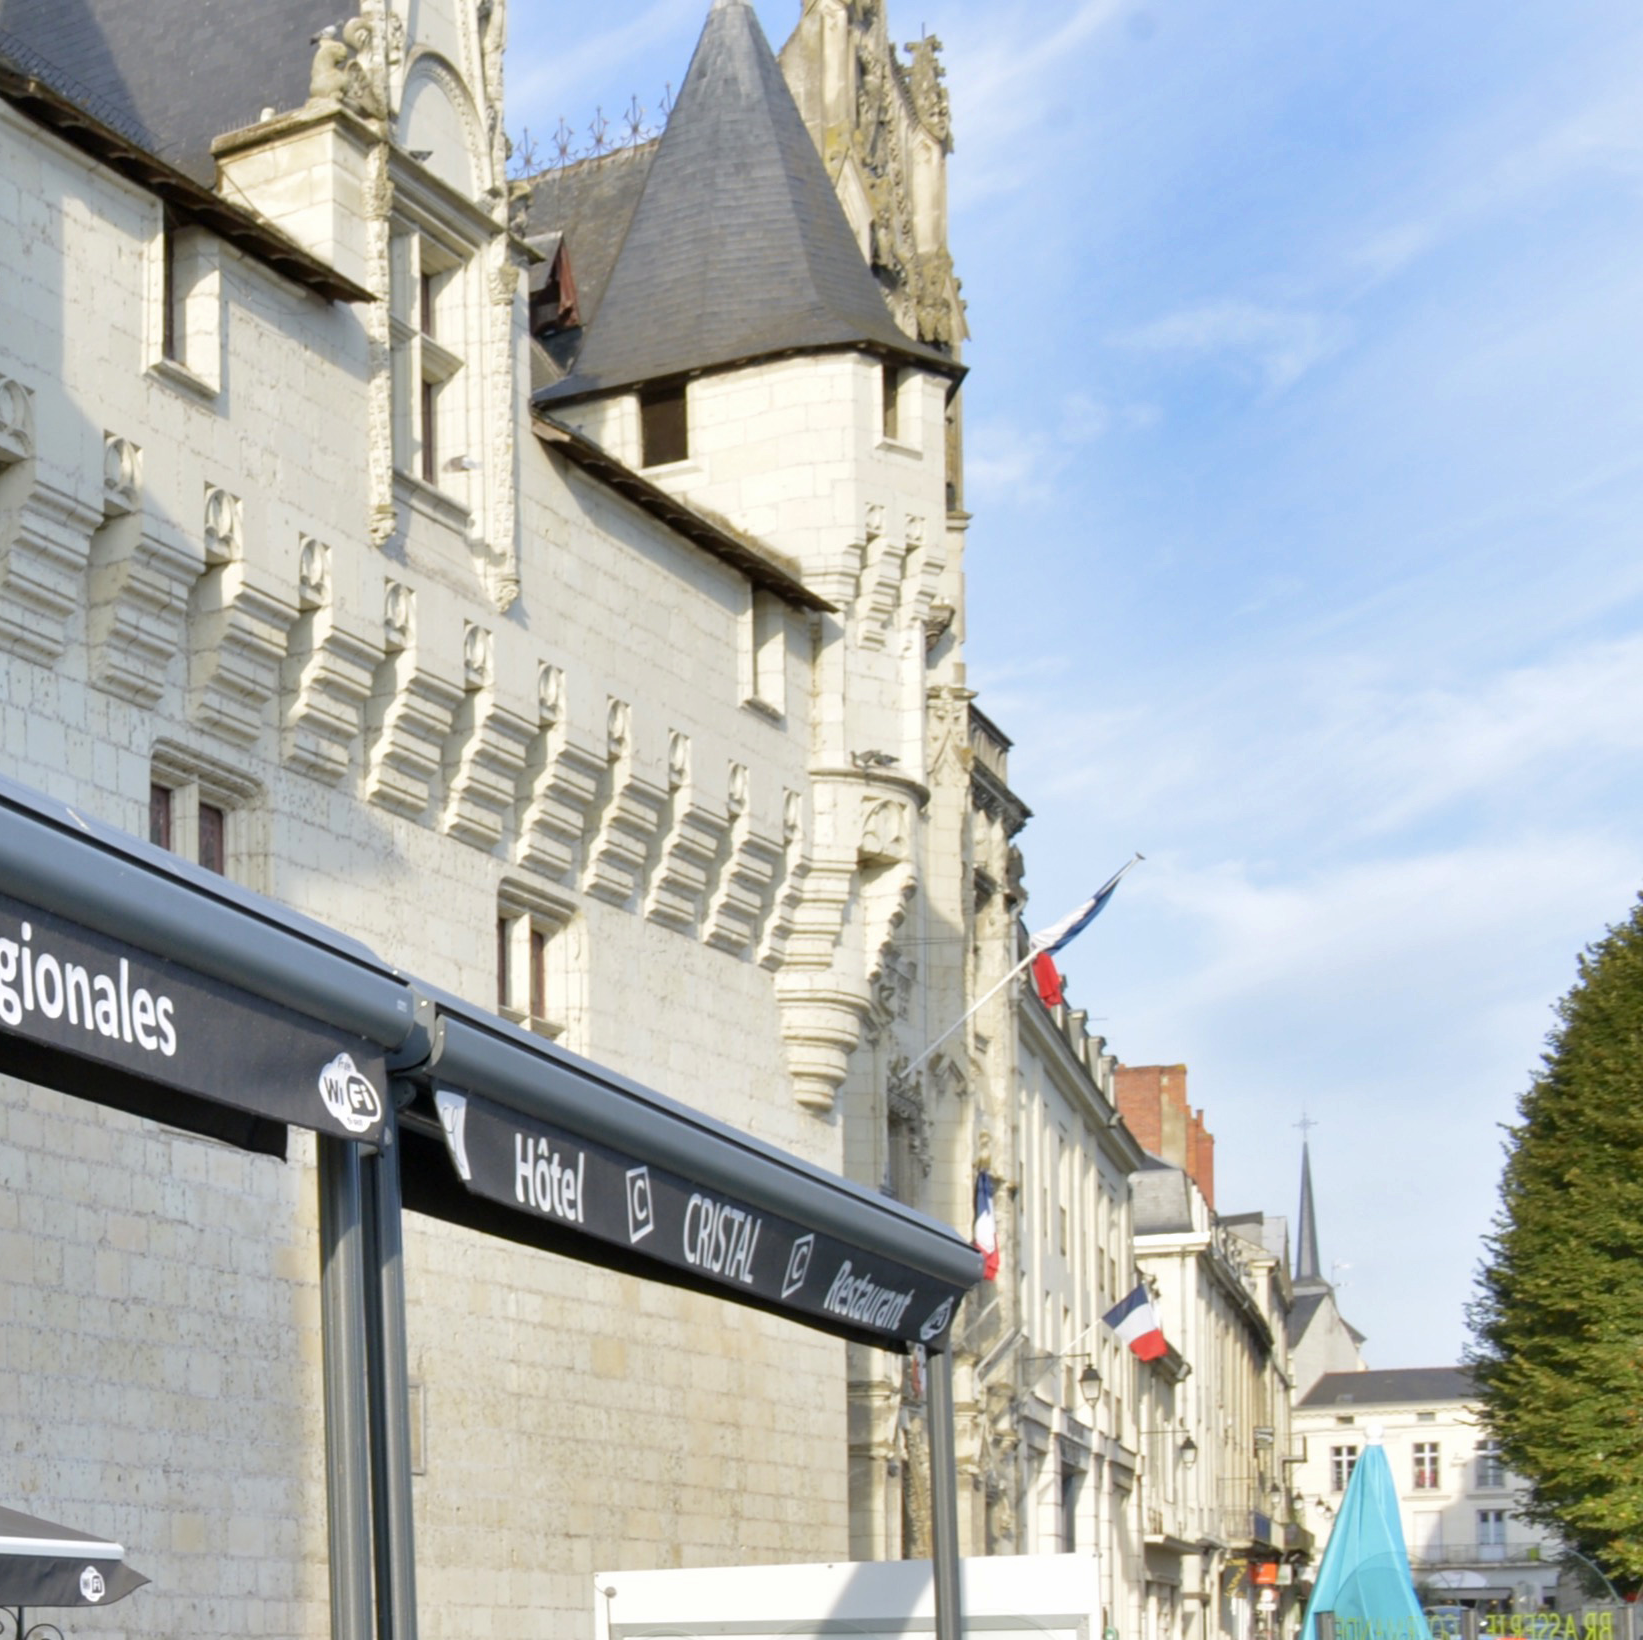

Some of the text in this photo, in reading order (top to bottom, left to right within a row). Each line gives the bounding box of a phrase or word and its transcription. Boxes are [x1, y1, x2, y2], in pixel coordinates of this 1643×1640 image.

[515, 1133, 584, 1224] Hôtel
[683, 1193, 763, 1285] CRISTAL
[824, 1259, 916, 1332] Restaurant
